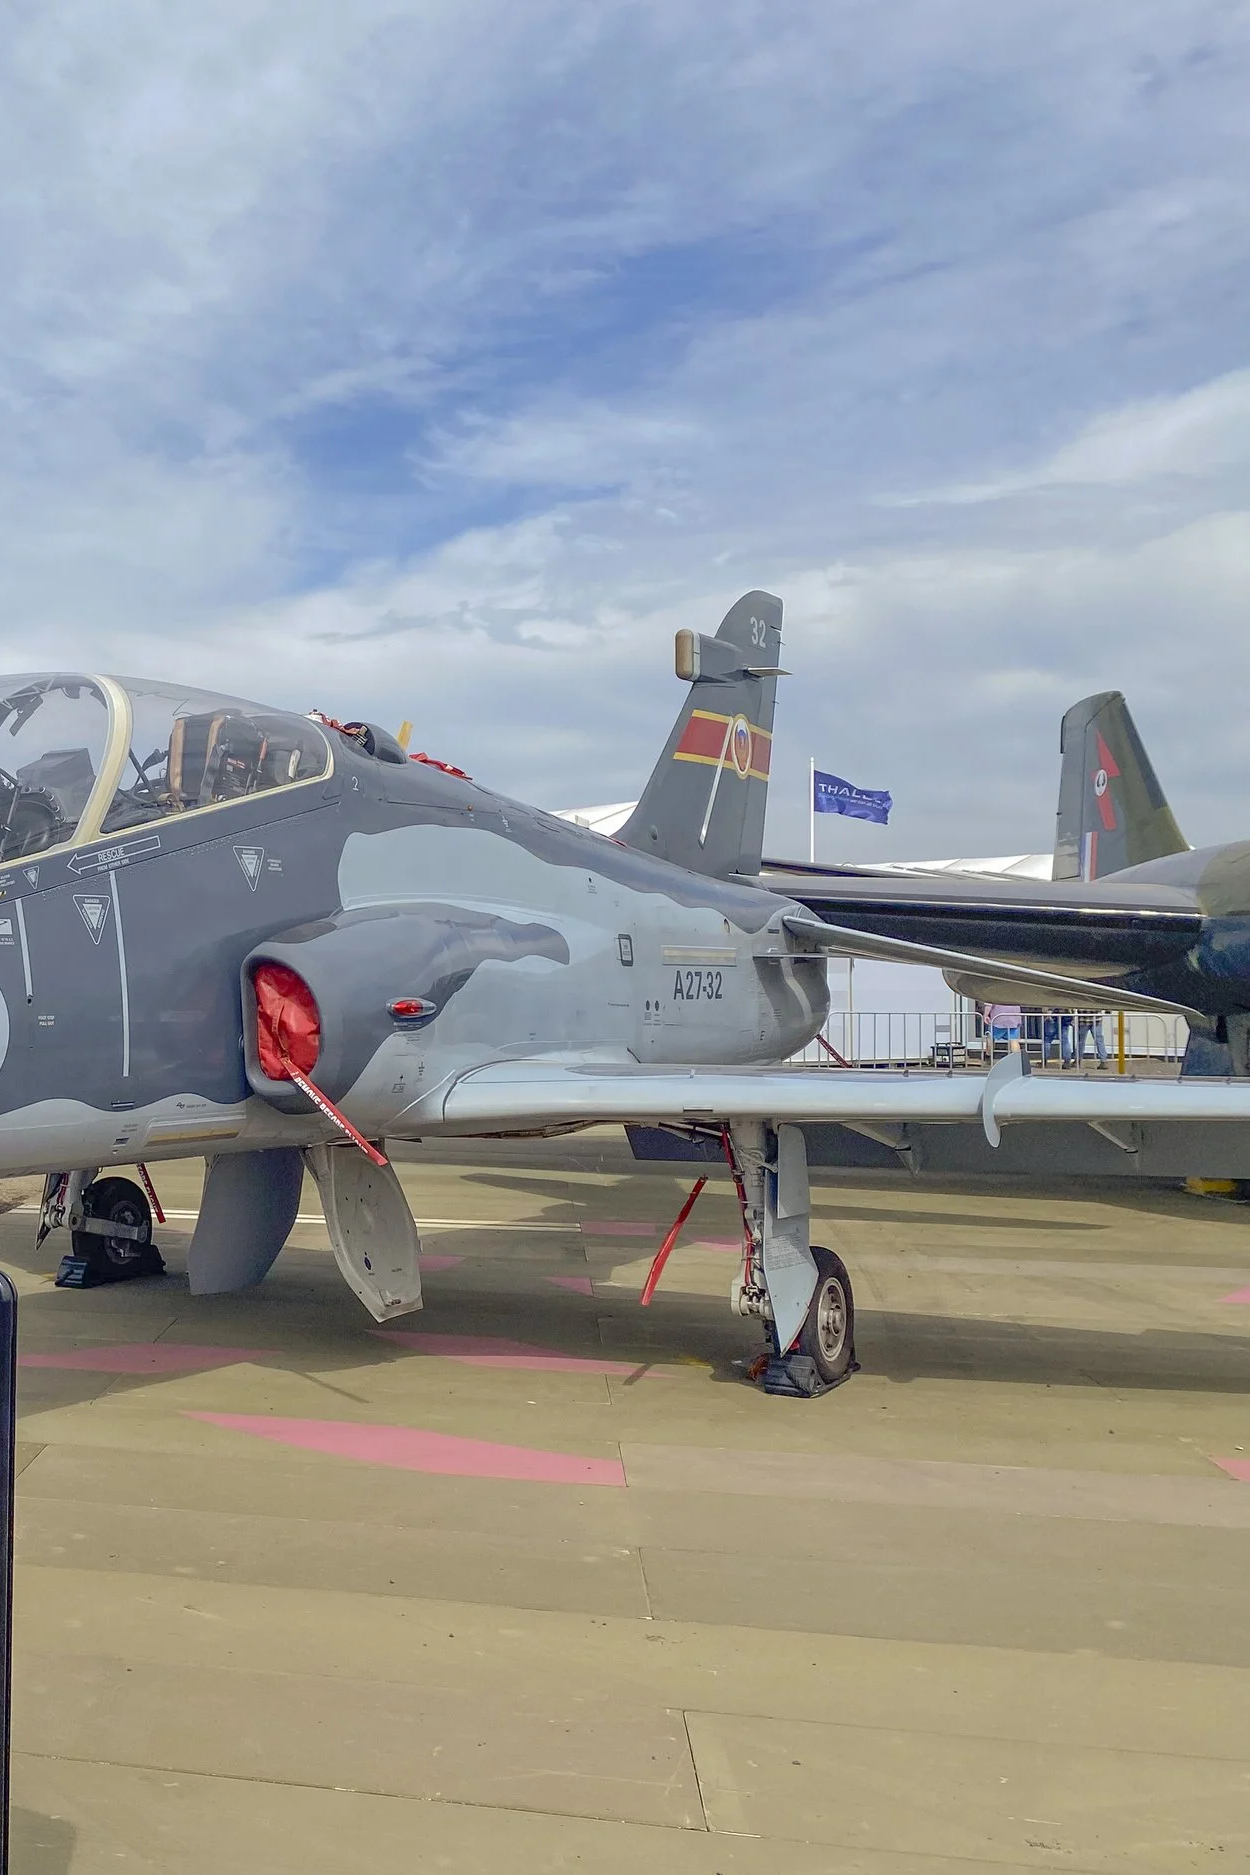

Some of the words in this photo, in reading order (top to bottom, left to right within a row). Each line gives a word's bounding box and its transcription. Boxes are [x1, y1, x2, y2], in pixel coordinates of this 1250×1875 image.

[750, 616, 767, 648] 32
[352, 776, 358, 791] 2
[98, 848, 125, 862] RESCUE
